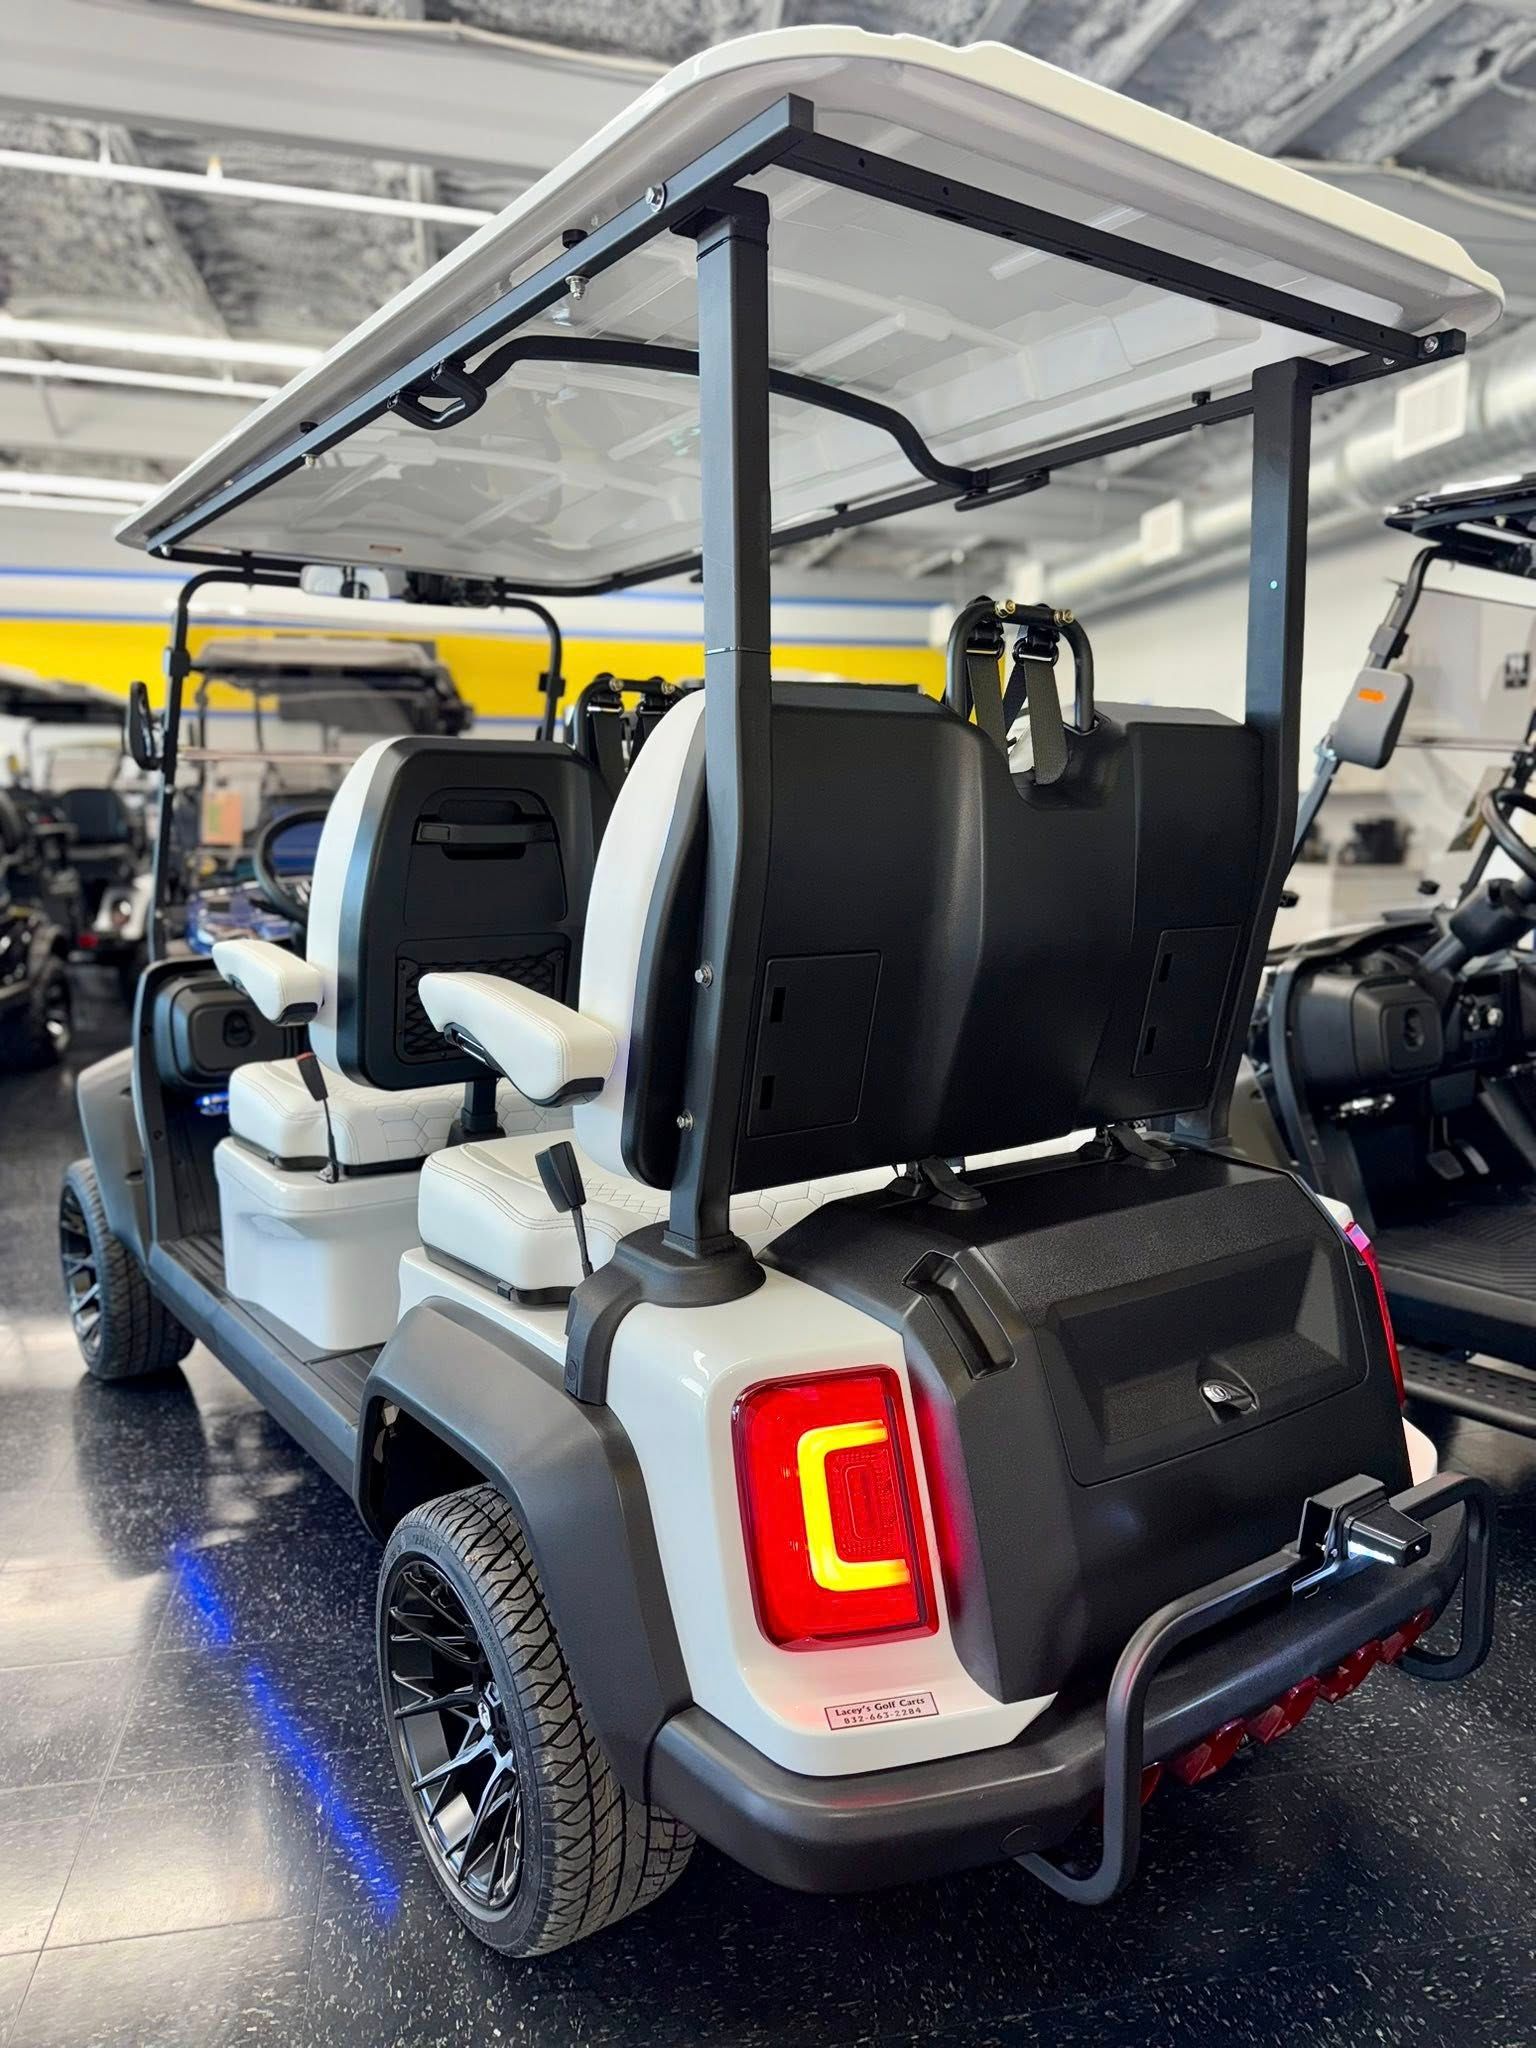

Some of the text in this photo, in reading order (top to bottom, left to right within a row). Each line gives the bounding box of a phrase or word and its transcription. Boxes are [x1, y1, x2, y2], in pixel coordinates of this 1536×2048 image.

[835, 1698, 925, 1717] Lacey's Golf Carts
[844, 1707, 922, 1724] 832-663-2284
